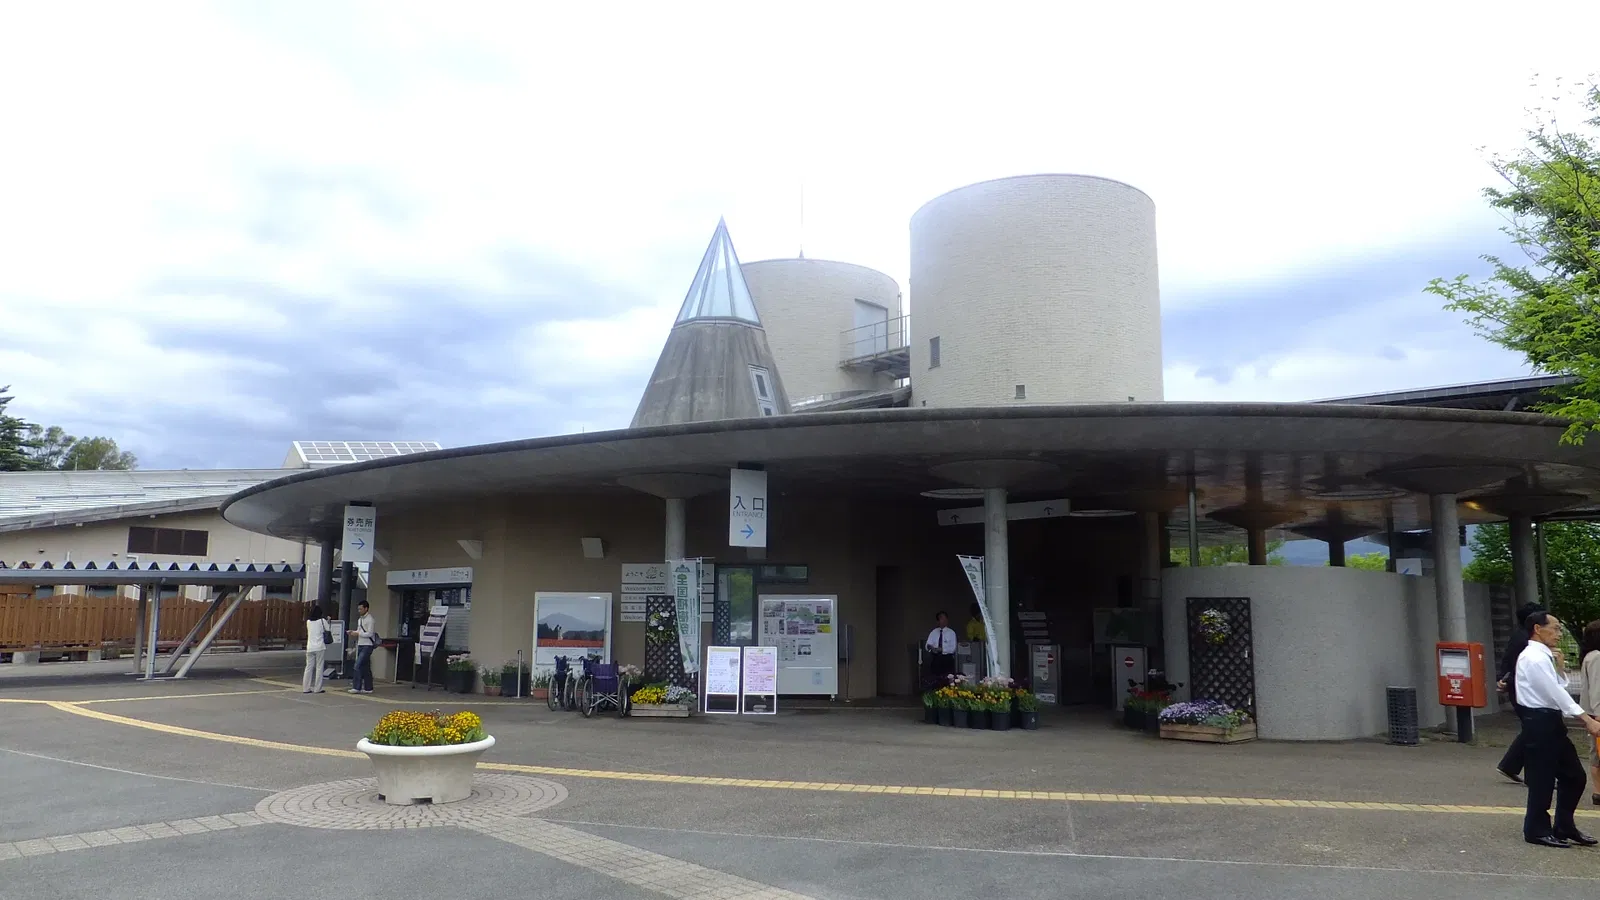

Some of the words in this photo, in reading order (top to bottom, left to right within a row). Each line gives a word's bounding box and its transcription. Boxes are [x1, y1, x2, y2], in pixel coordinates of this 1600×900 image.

[733, 495, 764, 511] 入口
[733, 511, 764, 519] ENTRANCE
[347, 517, 373, 527] 券売所
